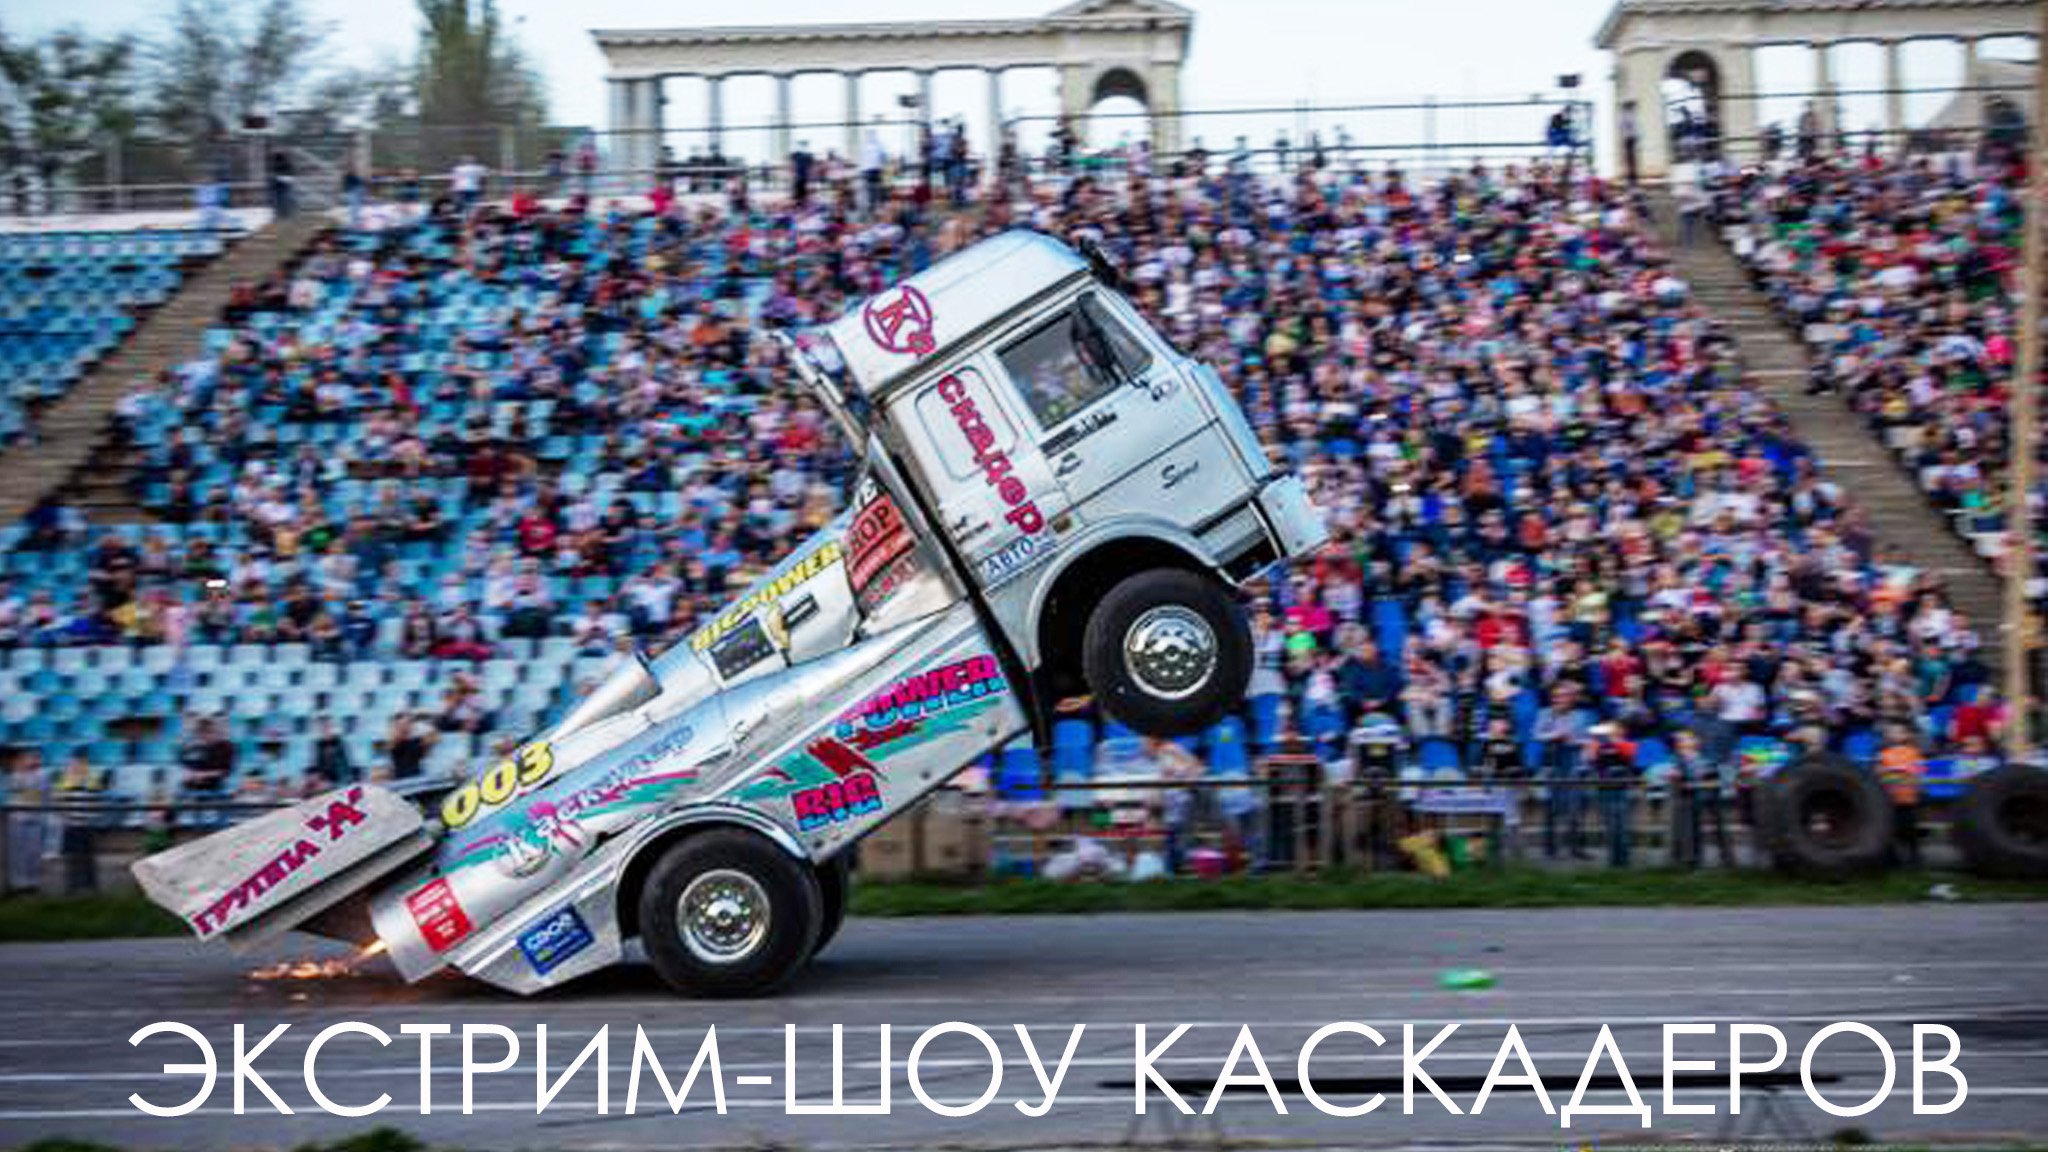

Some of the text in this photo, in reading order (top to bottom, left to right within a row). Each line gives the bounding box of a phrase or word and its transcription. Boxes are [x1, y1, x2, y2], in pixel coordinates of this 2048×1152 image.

[441, 741, 553, 827] 003
[791, 772, 883, 832] BIG
[192, 839, 321, 935] ГРУППА
